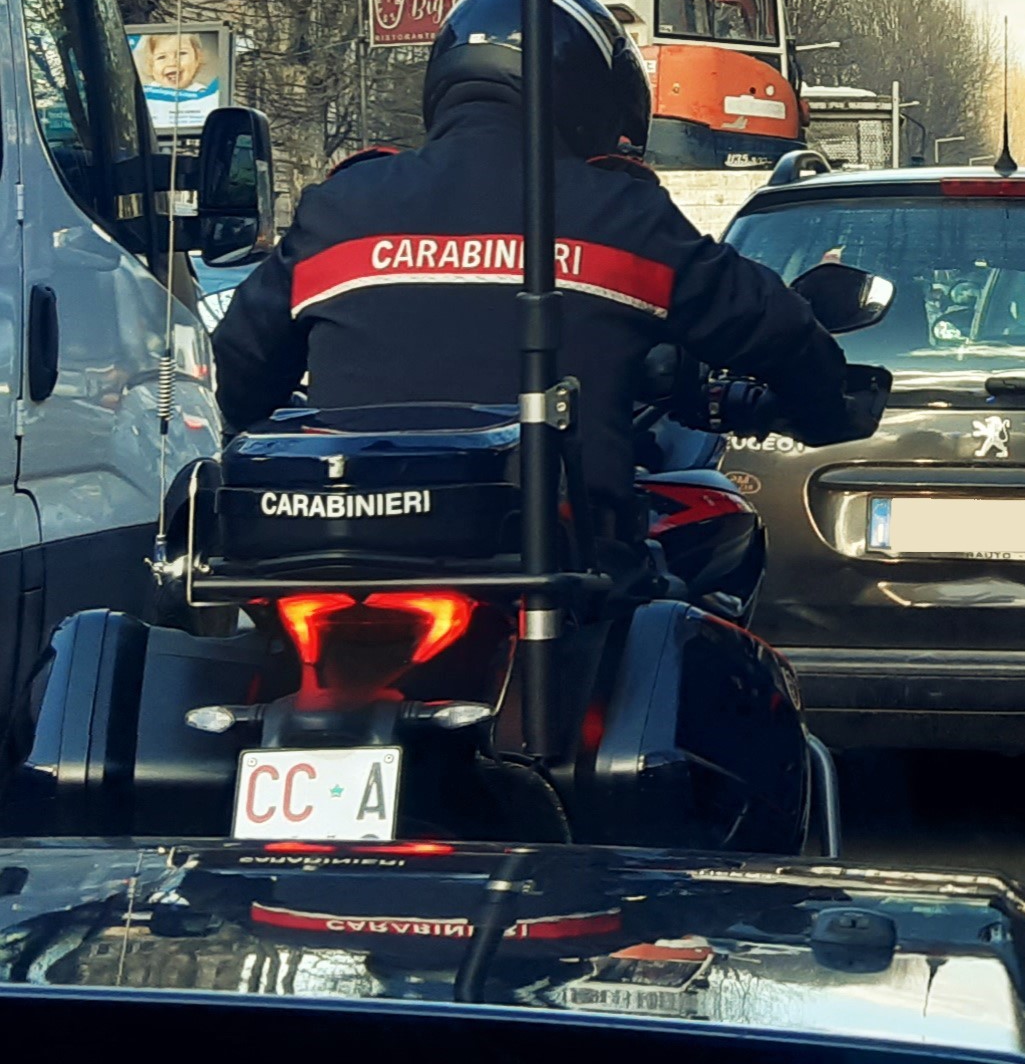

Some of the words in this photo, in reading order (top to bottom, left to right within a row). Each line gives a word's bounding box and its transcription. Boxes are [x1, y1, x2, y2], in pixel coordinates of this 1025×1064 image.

[371, 239, 583, 275] CARABINIRI
[260, 490, 431, 518] CARABINIERI
[246, 763, 317, 823] CC
[356, 762, 386, 820] A
